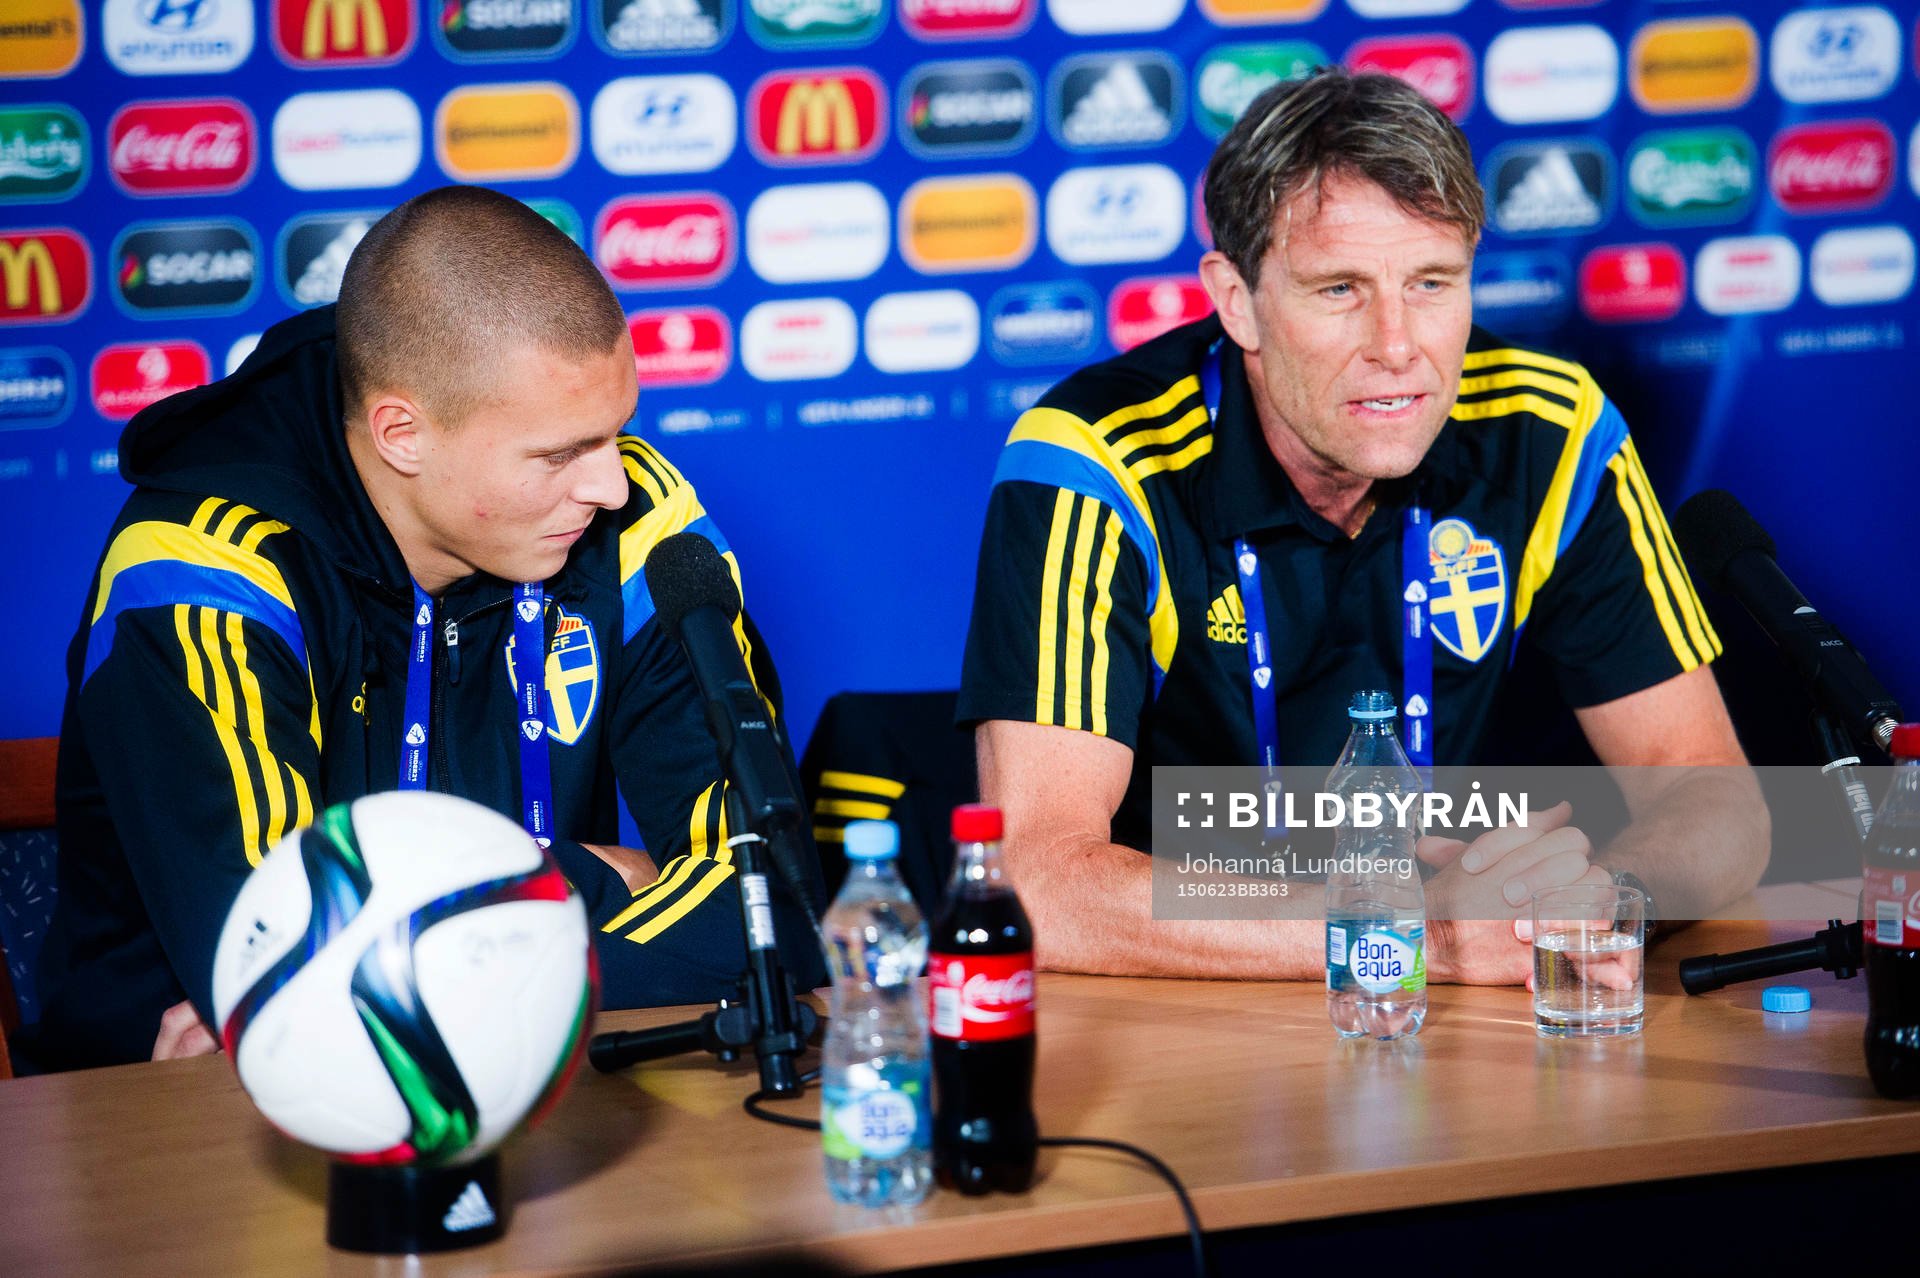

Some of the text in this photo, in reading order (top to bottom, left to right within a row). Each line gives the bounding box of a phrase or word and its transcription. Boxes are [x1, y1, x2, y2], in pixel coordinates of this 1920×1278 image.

[112, 120, 243, 173] Coca-Cola
[147, 249, 254, 286] SOCAR
[740, 720, 767, 730] AKG
[1358, 938, 1399, 960] Bon-
[1358, 960, 1402, 981] aqua
